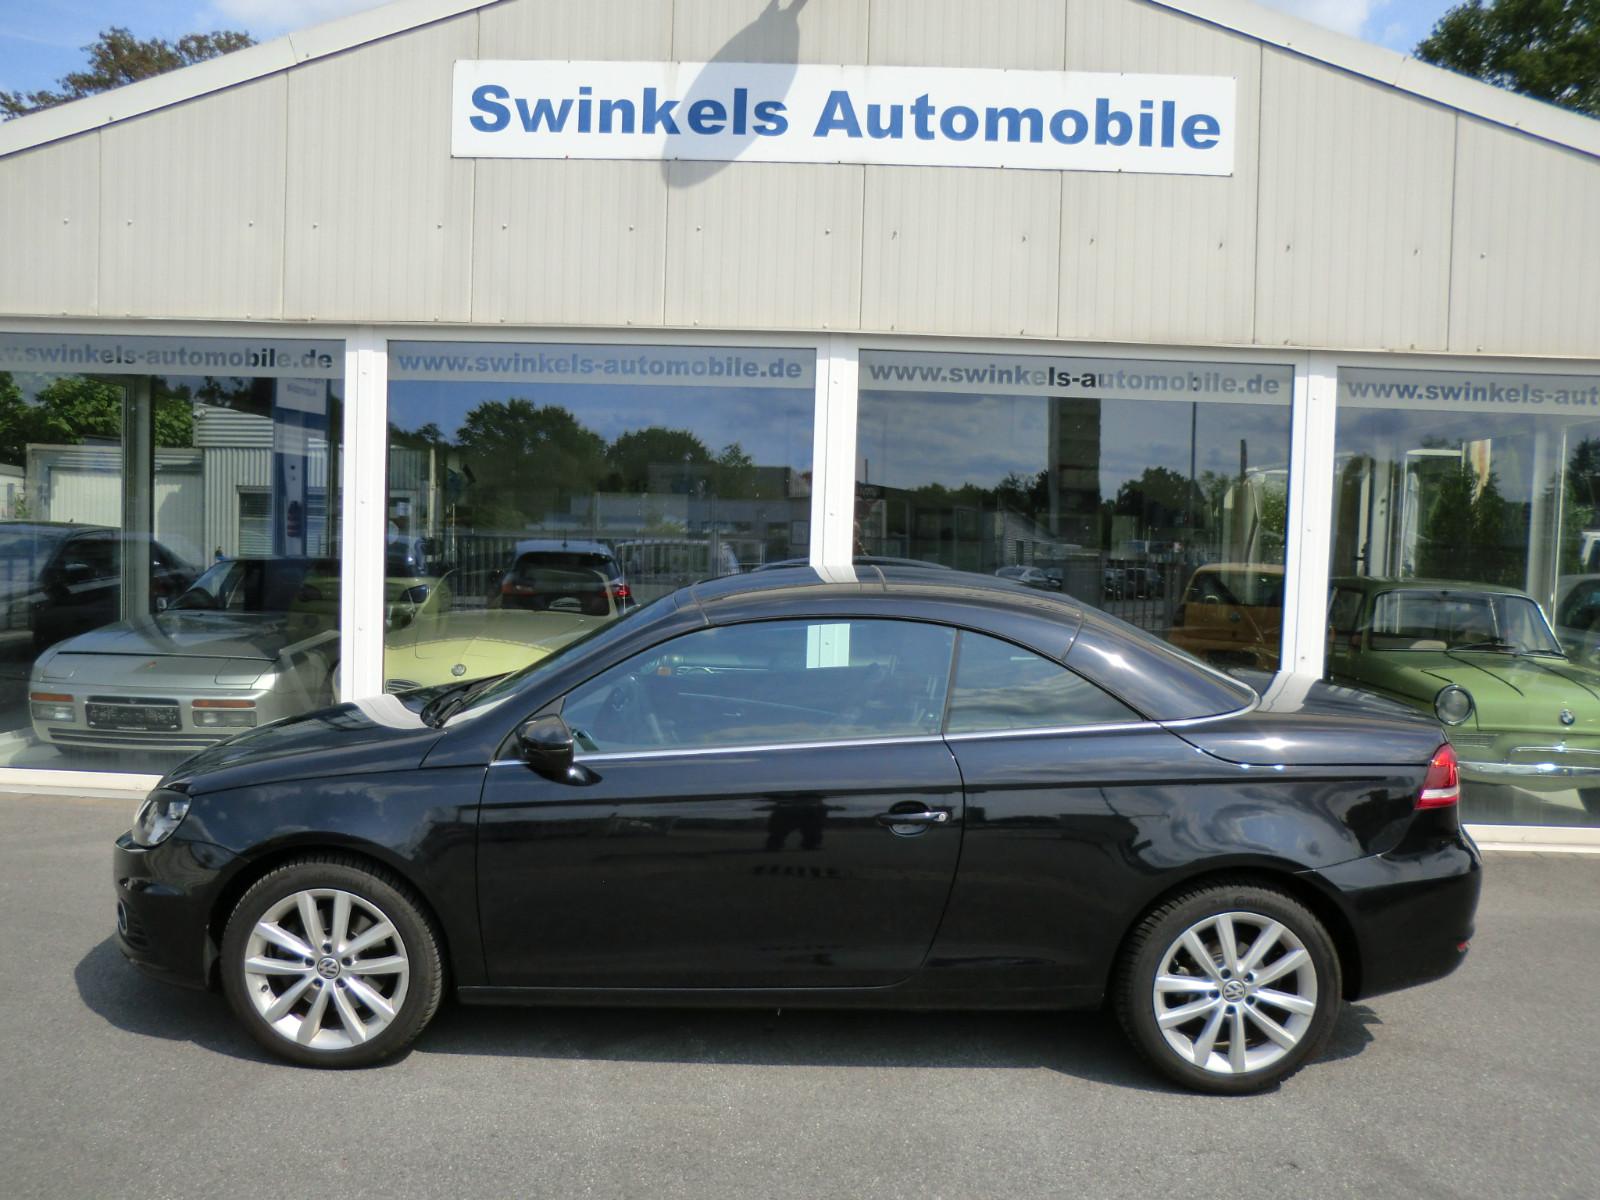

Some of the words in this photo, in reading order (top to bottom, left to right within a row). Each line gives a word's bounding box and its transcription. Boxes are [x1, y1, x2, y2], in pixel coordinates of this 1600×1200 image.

[469, 84, 789, 137] Swinkels
[813, 89, 1222, 151] Automobile
[398, 352, 802, 379] www.swinkels-automobile.de
[868, 362, 1281, 395] www.swinkels-automobile.de
